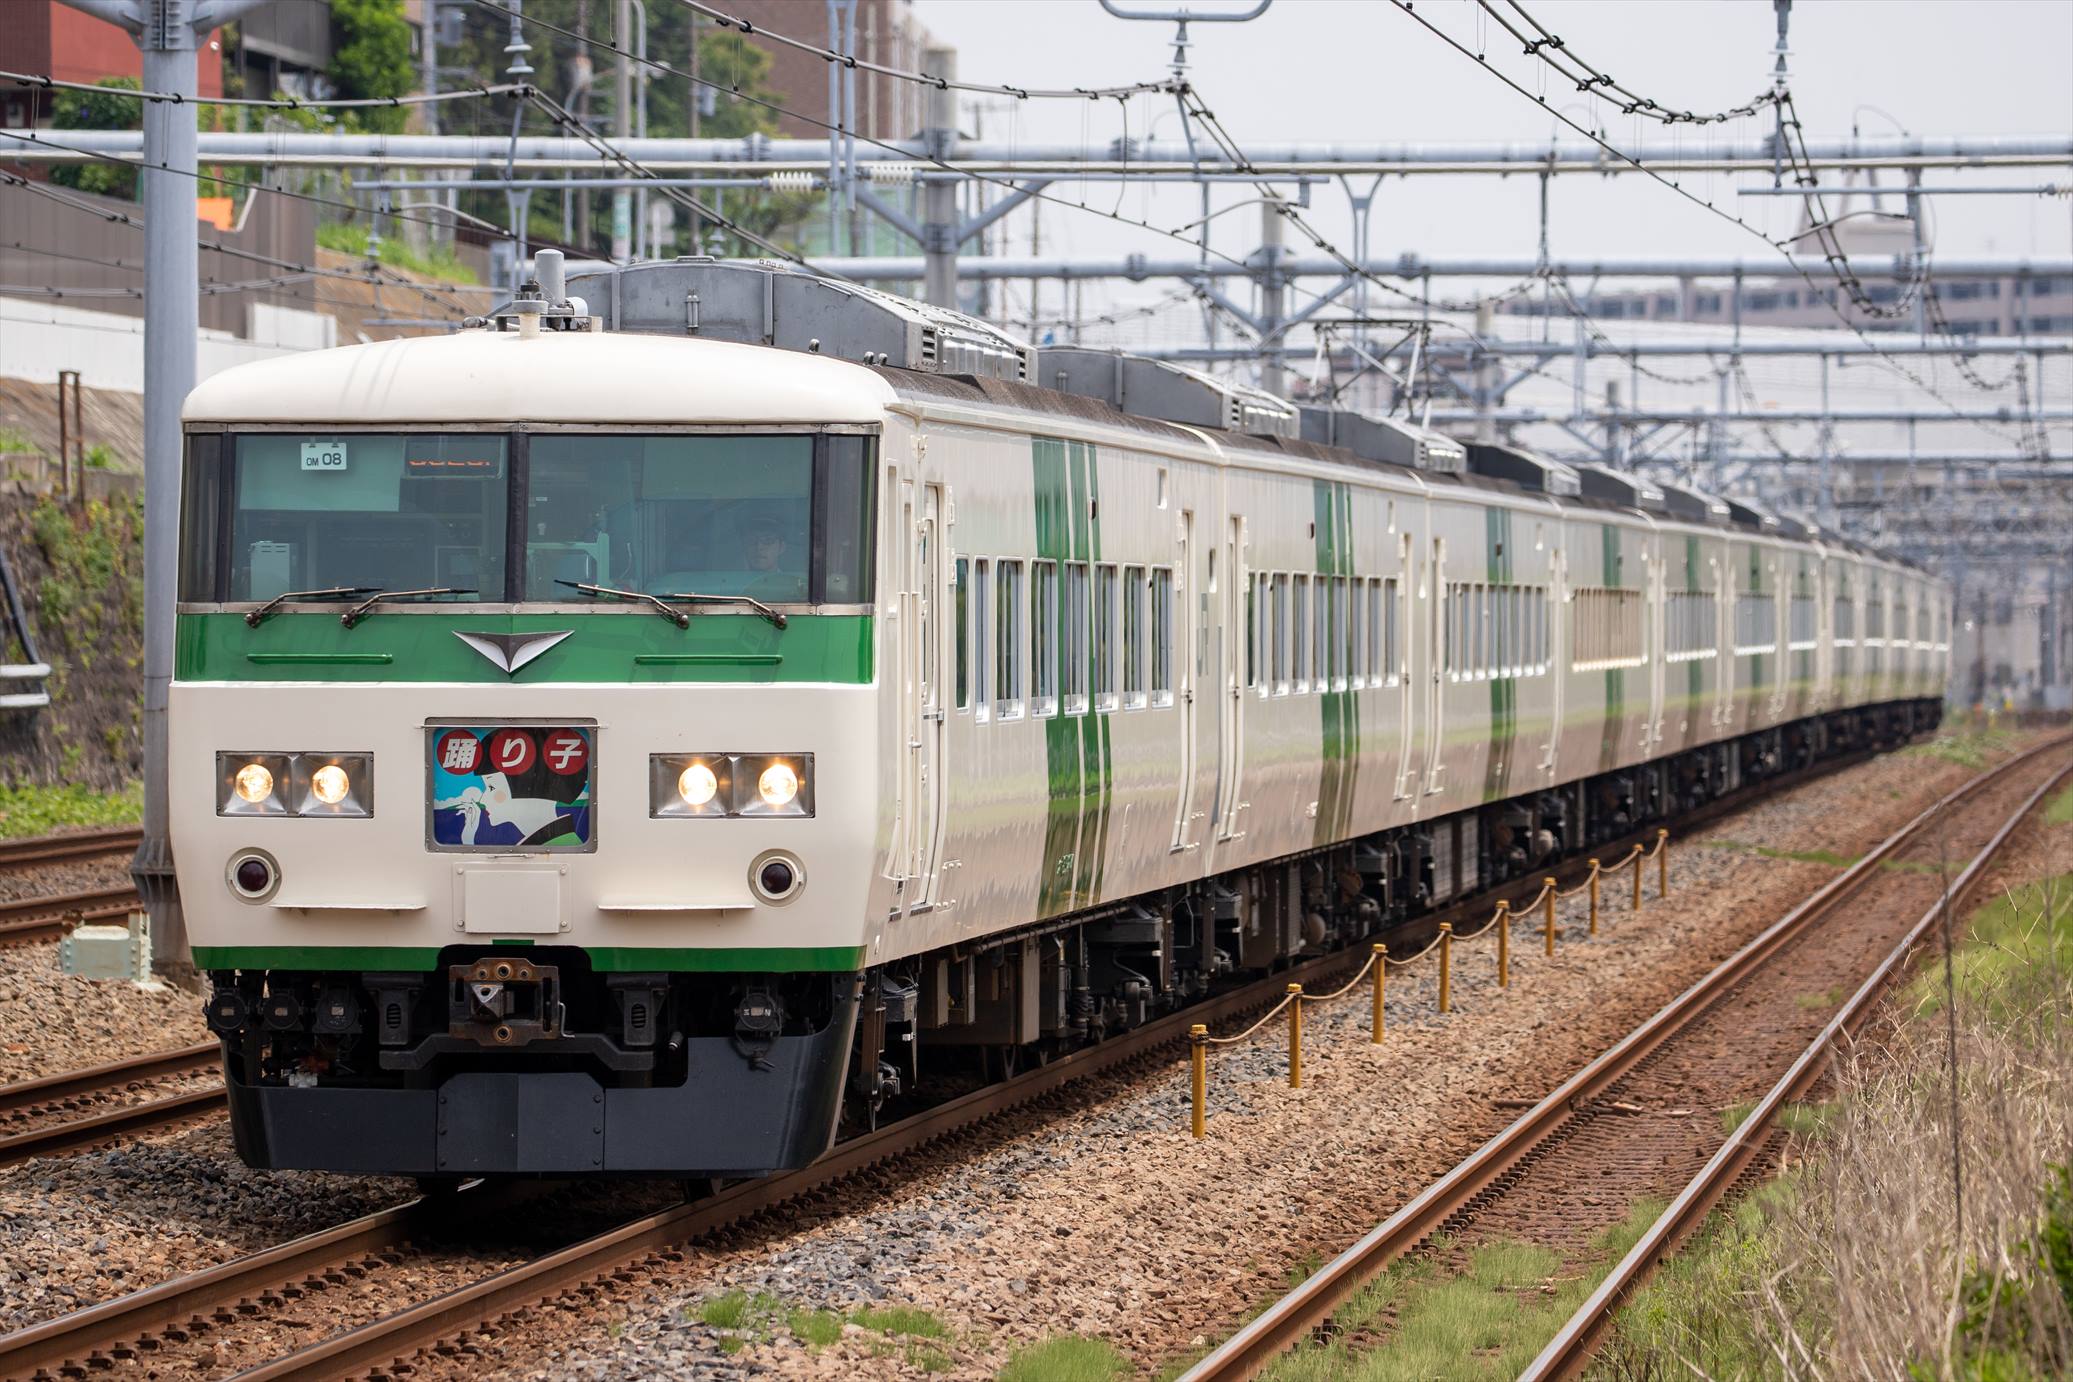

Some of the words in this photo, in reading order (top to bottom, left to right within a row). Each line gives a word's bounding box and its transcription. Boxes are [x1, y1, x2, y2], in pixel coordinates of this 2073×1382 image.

[306, 457, 319, 466] OM
[322, 453, 342, 465] 08
[442, 737, 583, 769] 踊り子
